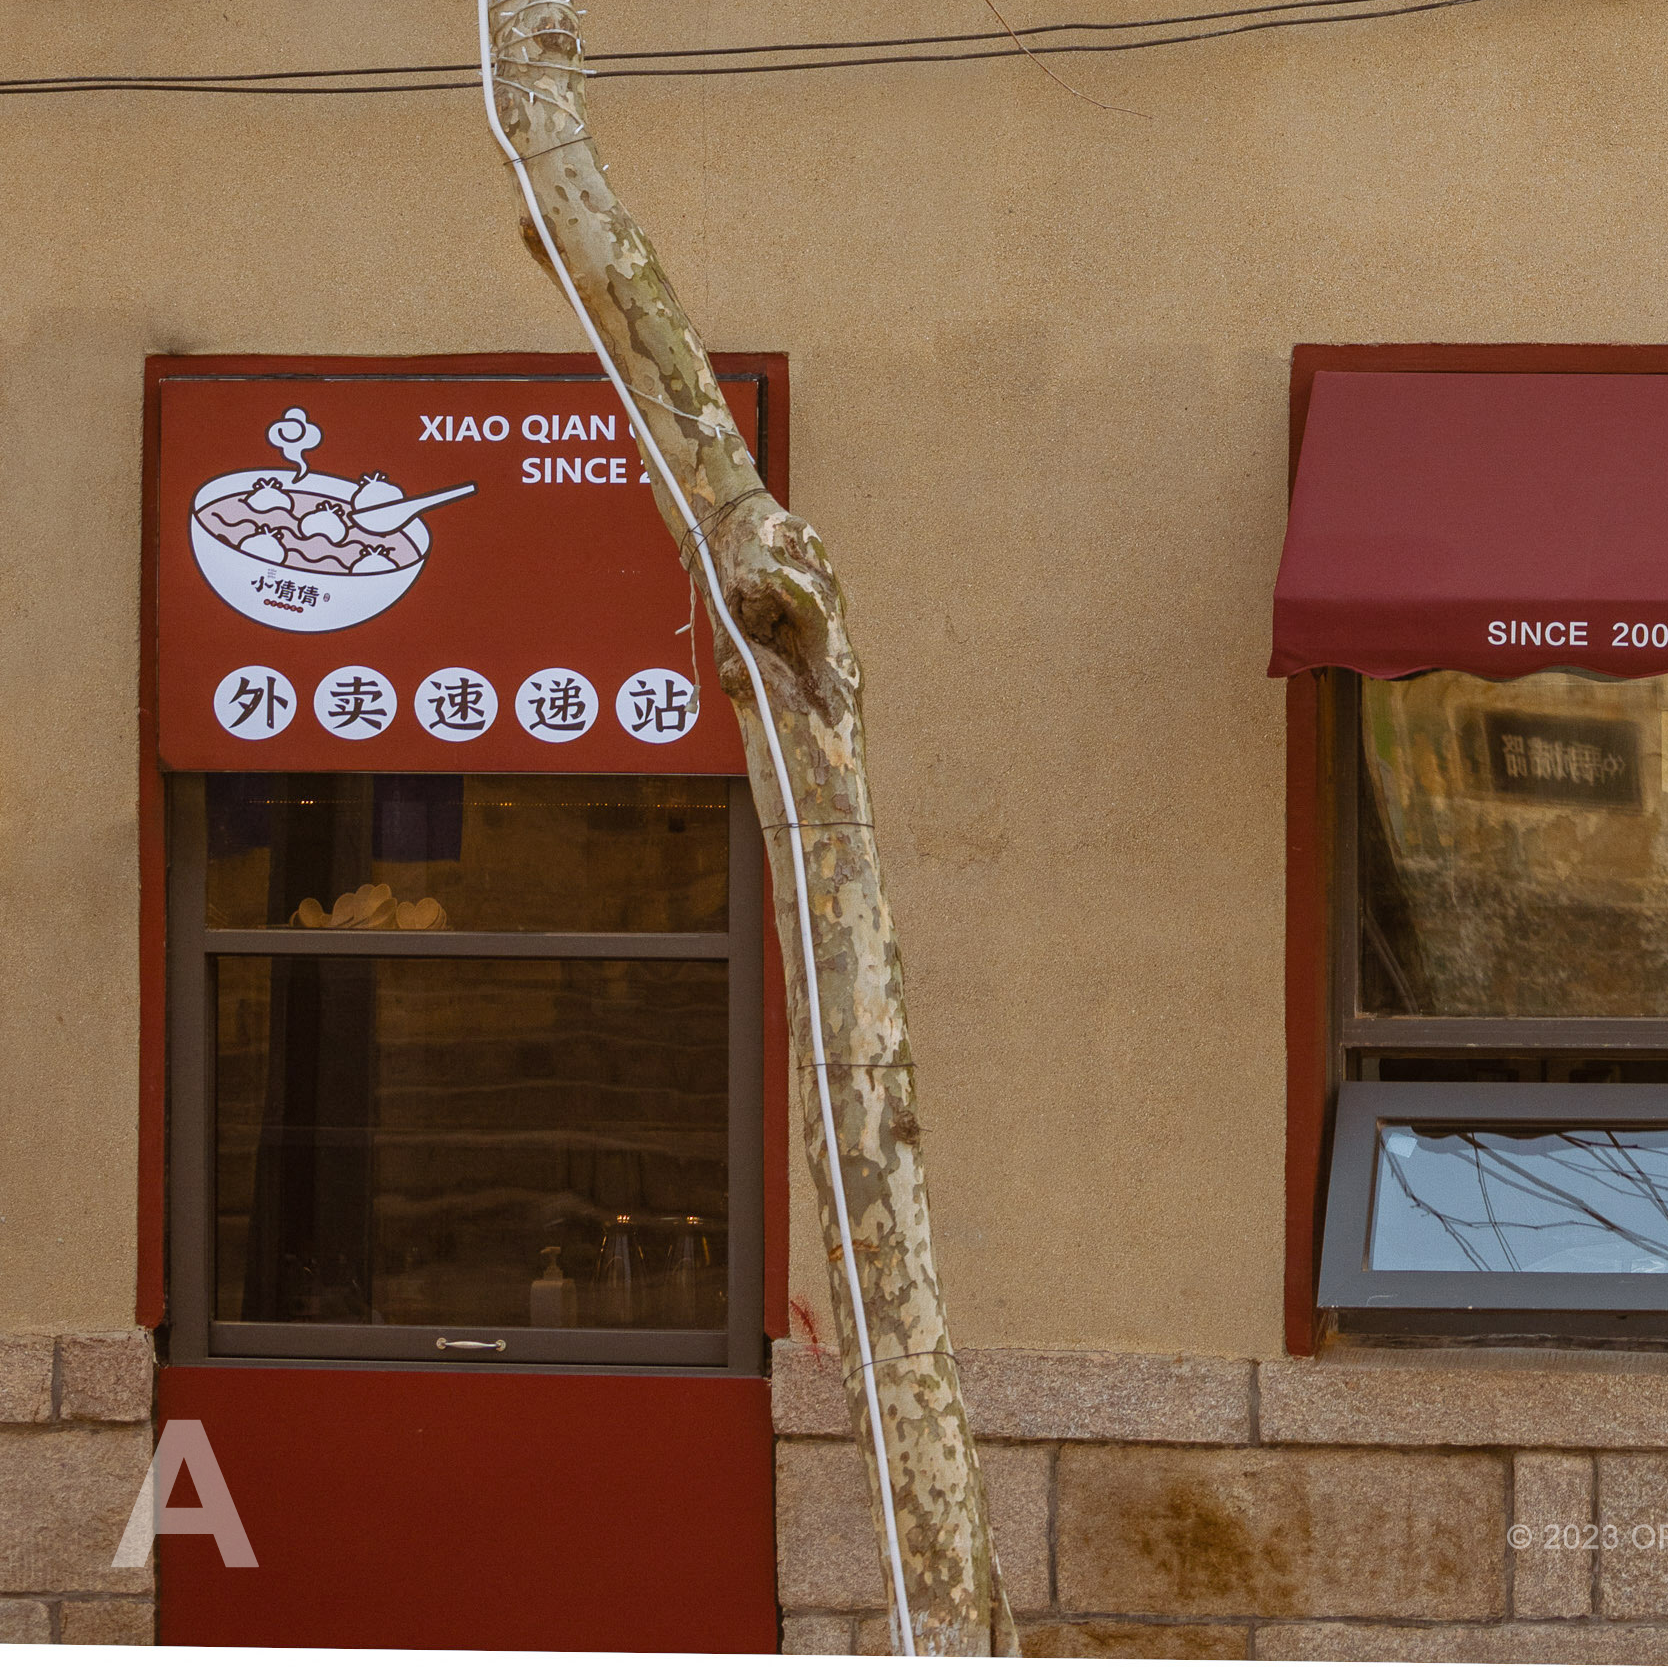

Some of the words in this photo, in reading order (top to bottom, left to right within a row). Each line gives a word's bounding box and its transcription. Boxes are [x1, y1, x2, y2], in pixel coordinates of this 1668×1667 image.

[419, 415, 509, 442] XIAO
[522, 414, 616, 444] QIAN
[522, 457, 627, 484] SINCE
[251, 575, 320, 607] 小倩倩
[1487, 620, 1588, 646] SINCE
[229, 675, 689, 733] 外卖速递站
